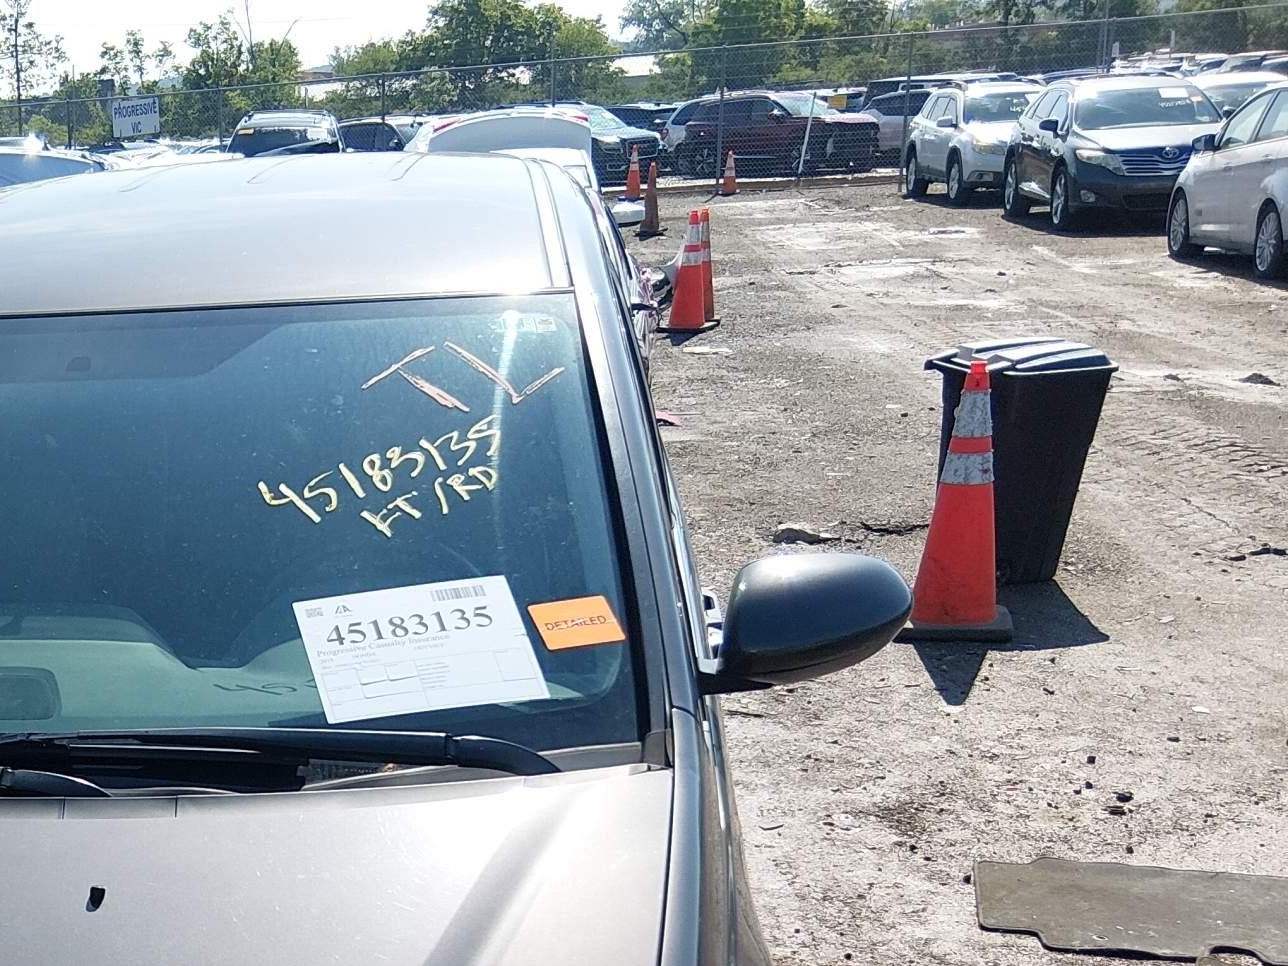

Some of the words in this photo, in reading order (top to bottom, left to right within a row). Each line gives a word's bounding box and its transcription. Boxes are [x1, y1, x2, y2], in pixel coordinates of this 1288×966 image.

[114, 101, 158, 119] PROGRESSIVE
[131, 121, 142, 133] VIC
[257, 413, 501, 524] 45183135
[325, 605, 493, 646] 45183135
[544, 615, 607, 631] DETAILED
